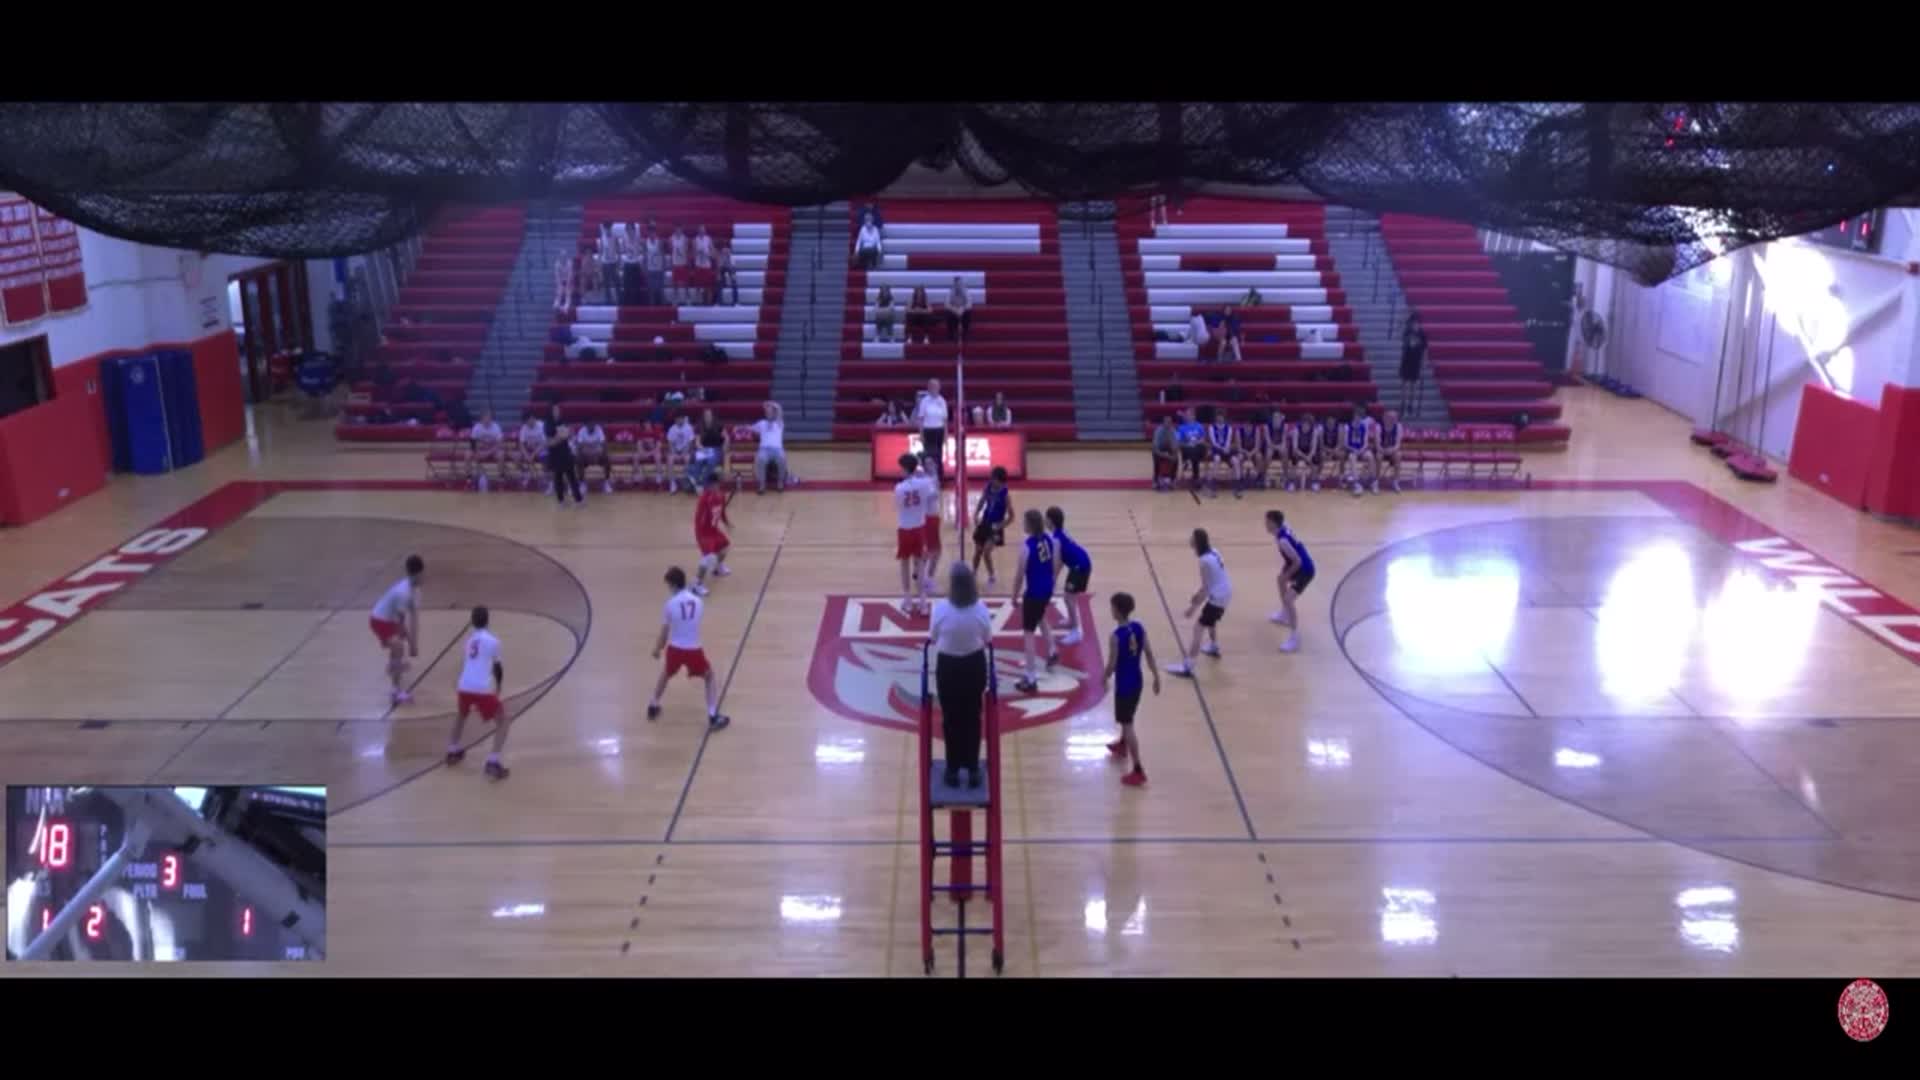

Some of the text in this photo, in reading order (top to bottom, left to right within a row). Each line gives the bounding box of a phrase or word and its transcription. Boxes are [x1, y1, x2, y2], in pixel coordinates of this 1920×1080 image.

[1037, 539, 1051, 562] 21
[680, 600, 696, 620] 17
[40, 824, 69, 867] 18
[163, 855, 177, 886] 3
[87, 906, 103, 936] 2
[242, 908, 251, 935] 1
